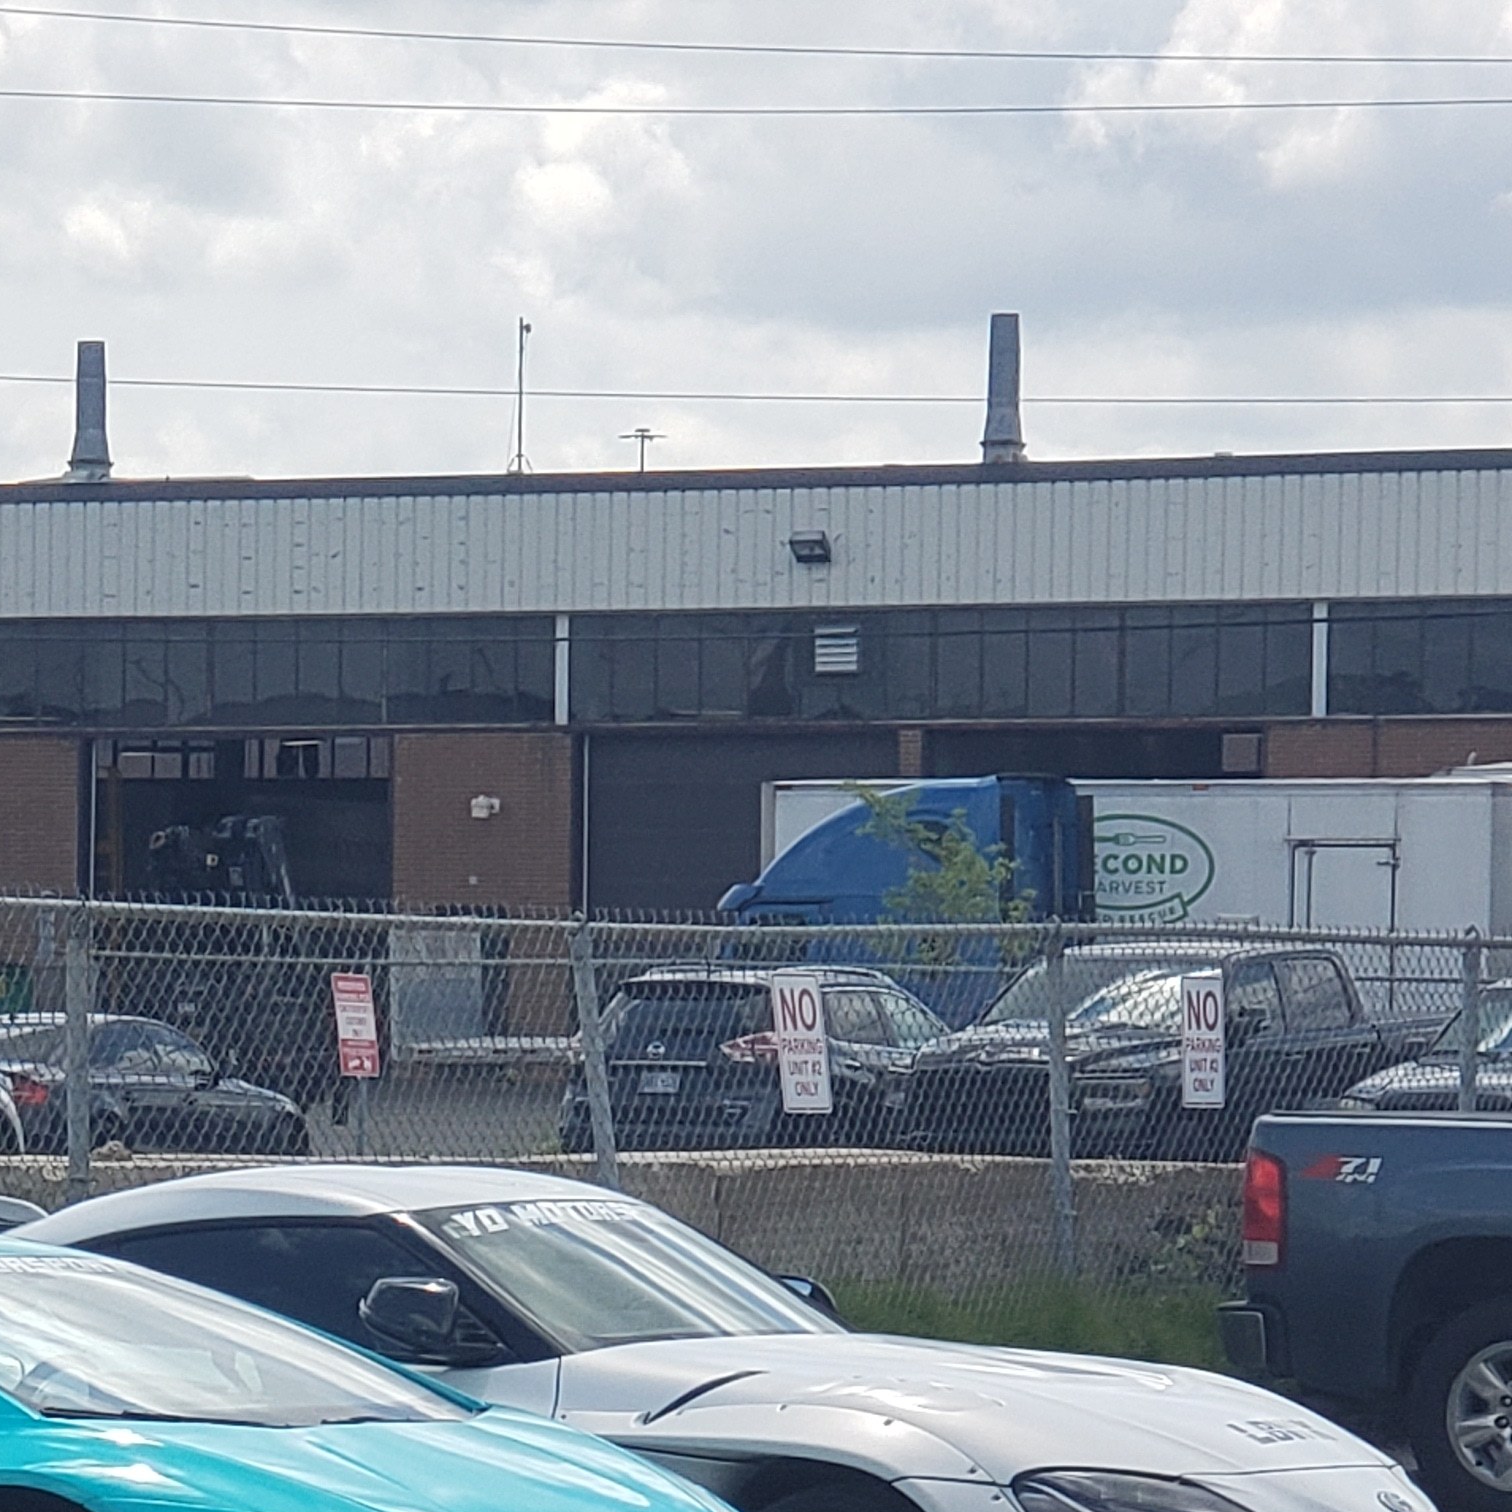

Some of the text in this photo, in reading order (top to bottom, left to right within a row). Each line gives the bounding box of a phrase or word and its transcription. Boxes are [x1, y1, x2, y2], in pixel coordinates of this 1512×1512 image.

[779, 987, 817, 1032] NO
[1186, 989, 1219, 1032] NO
[782, 1037, 823, 1055] PARKING
[1185, 1037, 1221, 1053] PARKING
[789, 1060, 809, 1076] UNIT
[795, 1081, 819, 1097] ONLY
[1193, 1078, 1215, 1093] ONLY
